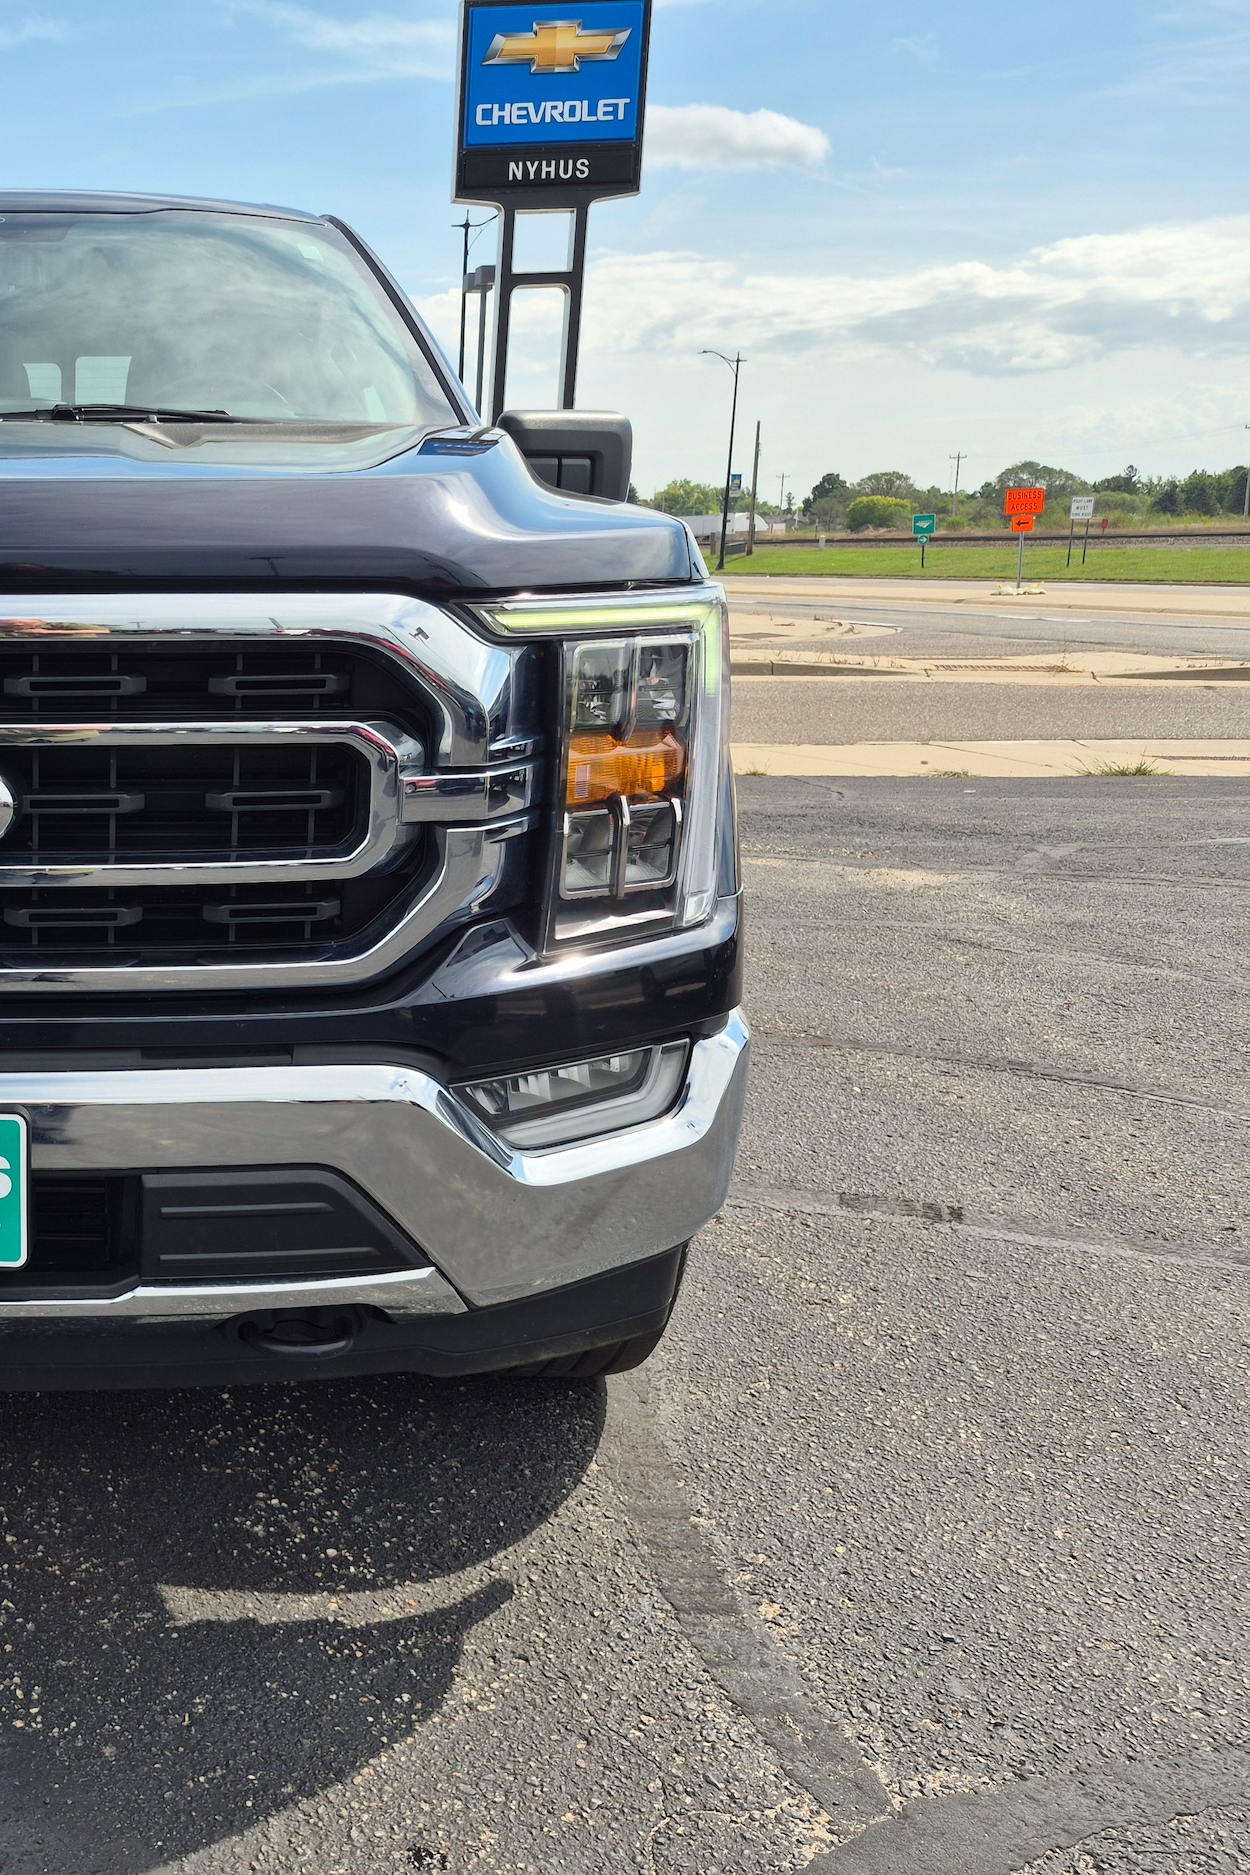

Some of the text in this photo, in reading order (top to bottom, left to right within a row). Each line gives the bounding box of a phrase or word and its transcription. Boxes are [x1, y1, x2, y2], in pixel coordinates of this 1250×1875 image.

[475, 98, 631, 126] CHEVROLET
[508, 158, 590, 182] NYHUS
[1008, 490, 1042, 500] BUSINESS
[1010, 502, 1038, 512] ACCESS
